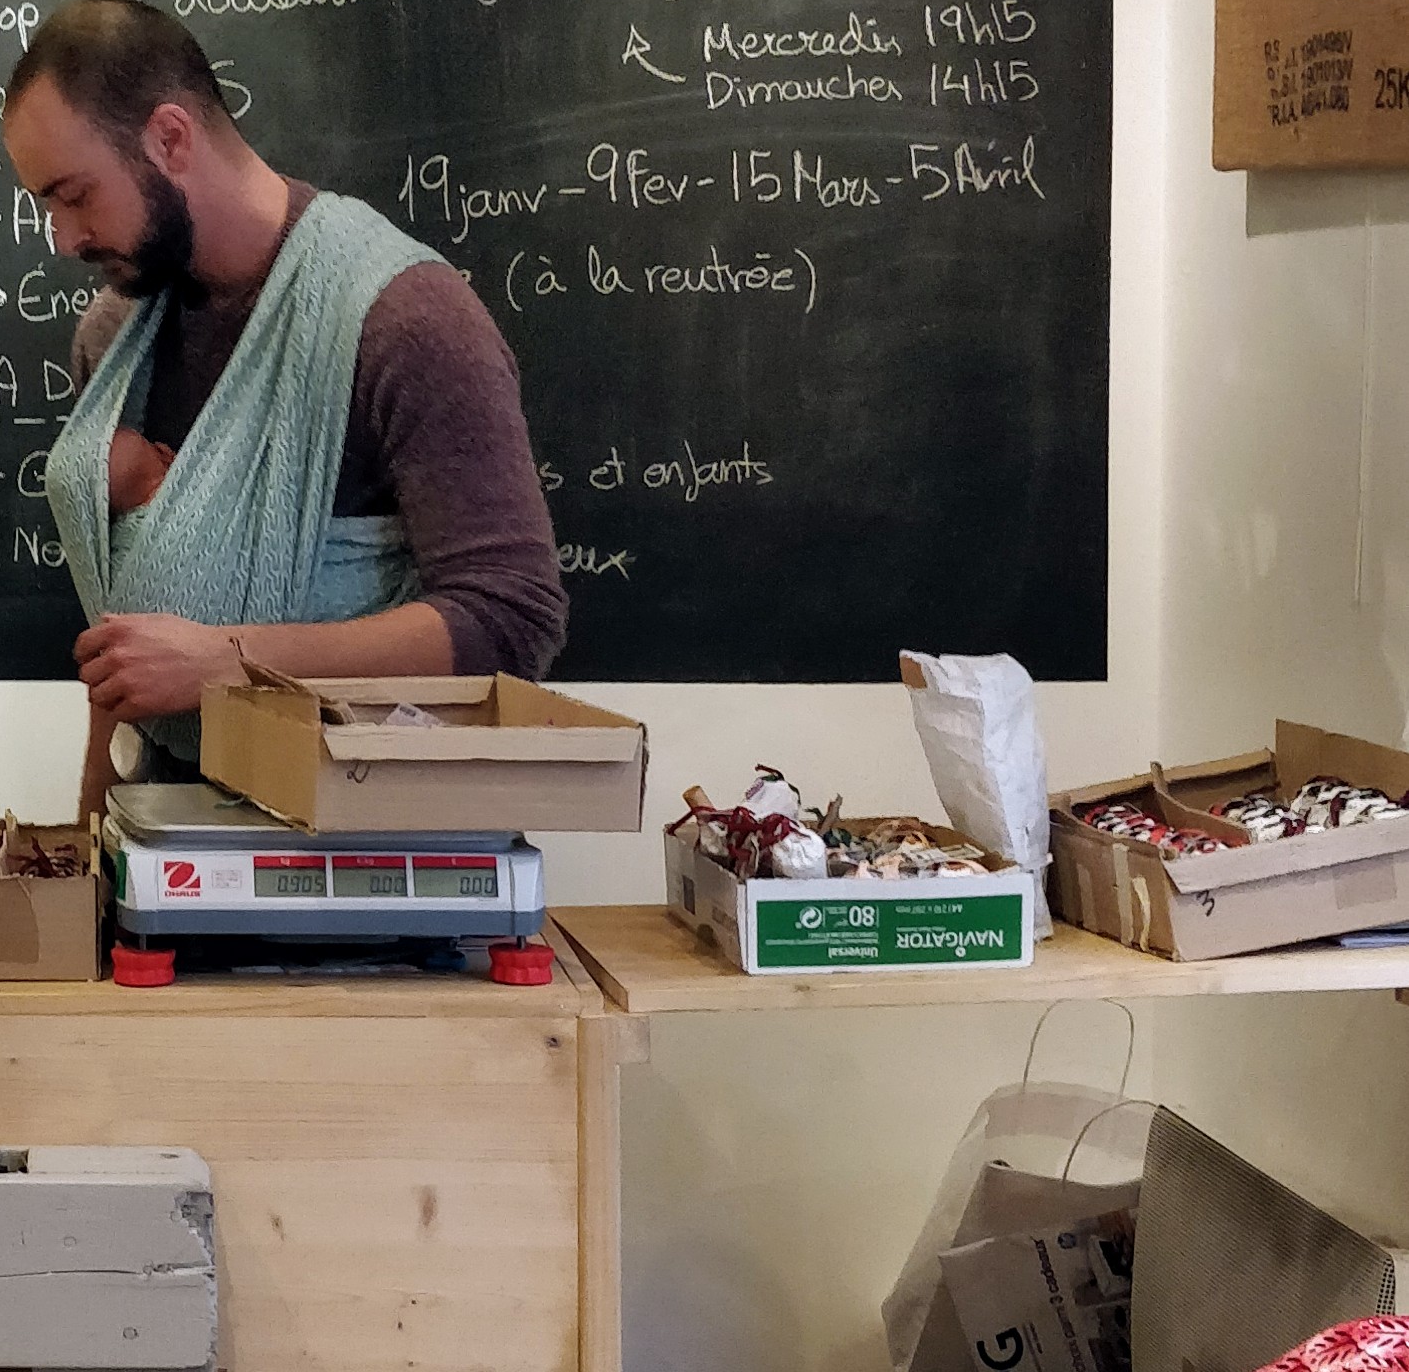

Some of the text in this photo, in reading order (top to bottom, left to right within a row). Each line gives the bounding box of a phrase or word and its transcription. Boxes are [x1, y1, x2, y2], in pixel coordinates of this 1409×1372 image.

[924, 0, 1037, 47] 19h15
[930, 58, 1040, 106] 14h15
[587, 244, 635, 295] la
[590, 447, 626, 491] et
[643, 440, 774, 503] enfants
[848, 905, 876, 927] 80
[1194, 890, 1215, 916] 3
[828, 947, 879, 959] Universal
[896, 929, 1004, 957] NAVIGATOR
